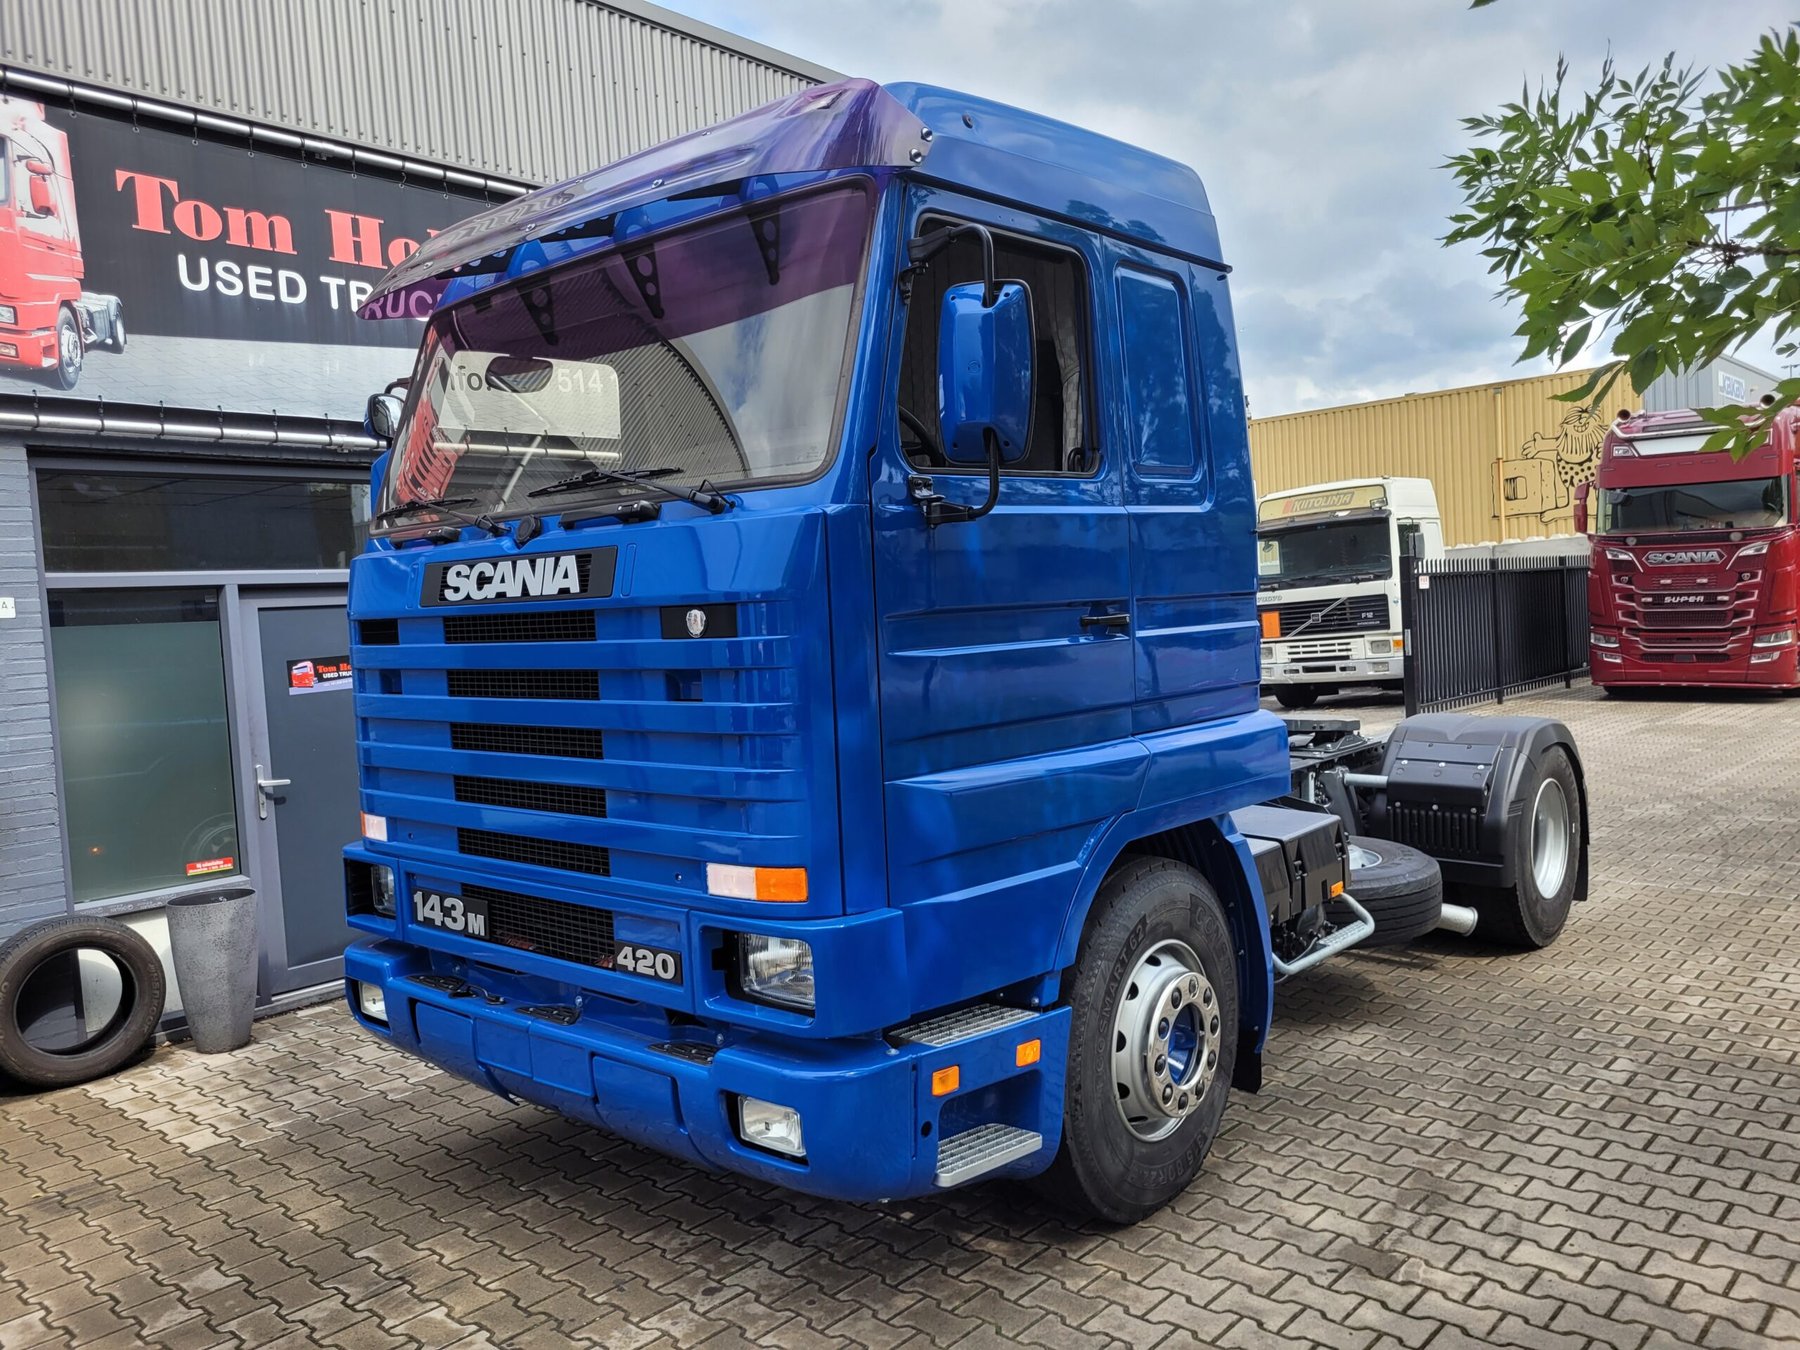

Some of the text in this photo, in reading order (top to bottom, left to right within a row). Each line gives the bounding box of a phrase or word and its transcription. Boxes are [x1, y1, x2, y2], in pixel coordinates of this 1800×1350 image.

[115, 169, 298, 255] Tom
[177, 253, 308, 304] USED
[1647, 551, 1721, 563] SCANIA
[443, 554, 581, 602] SCANIA
[1663, 595, 1705, 603] SUPER
[316, 665, 337, 673] Tom
[616, 946, 676, 980] 420
